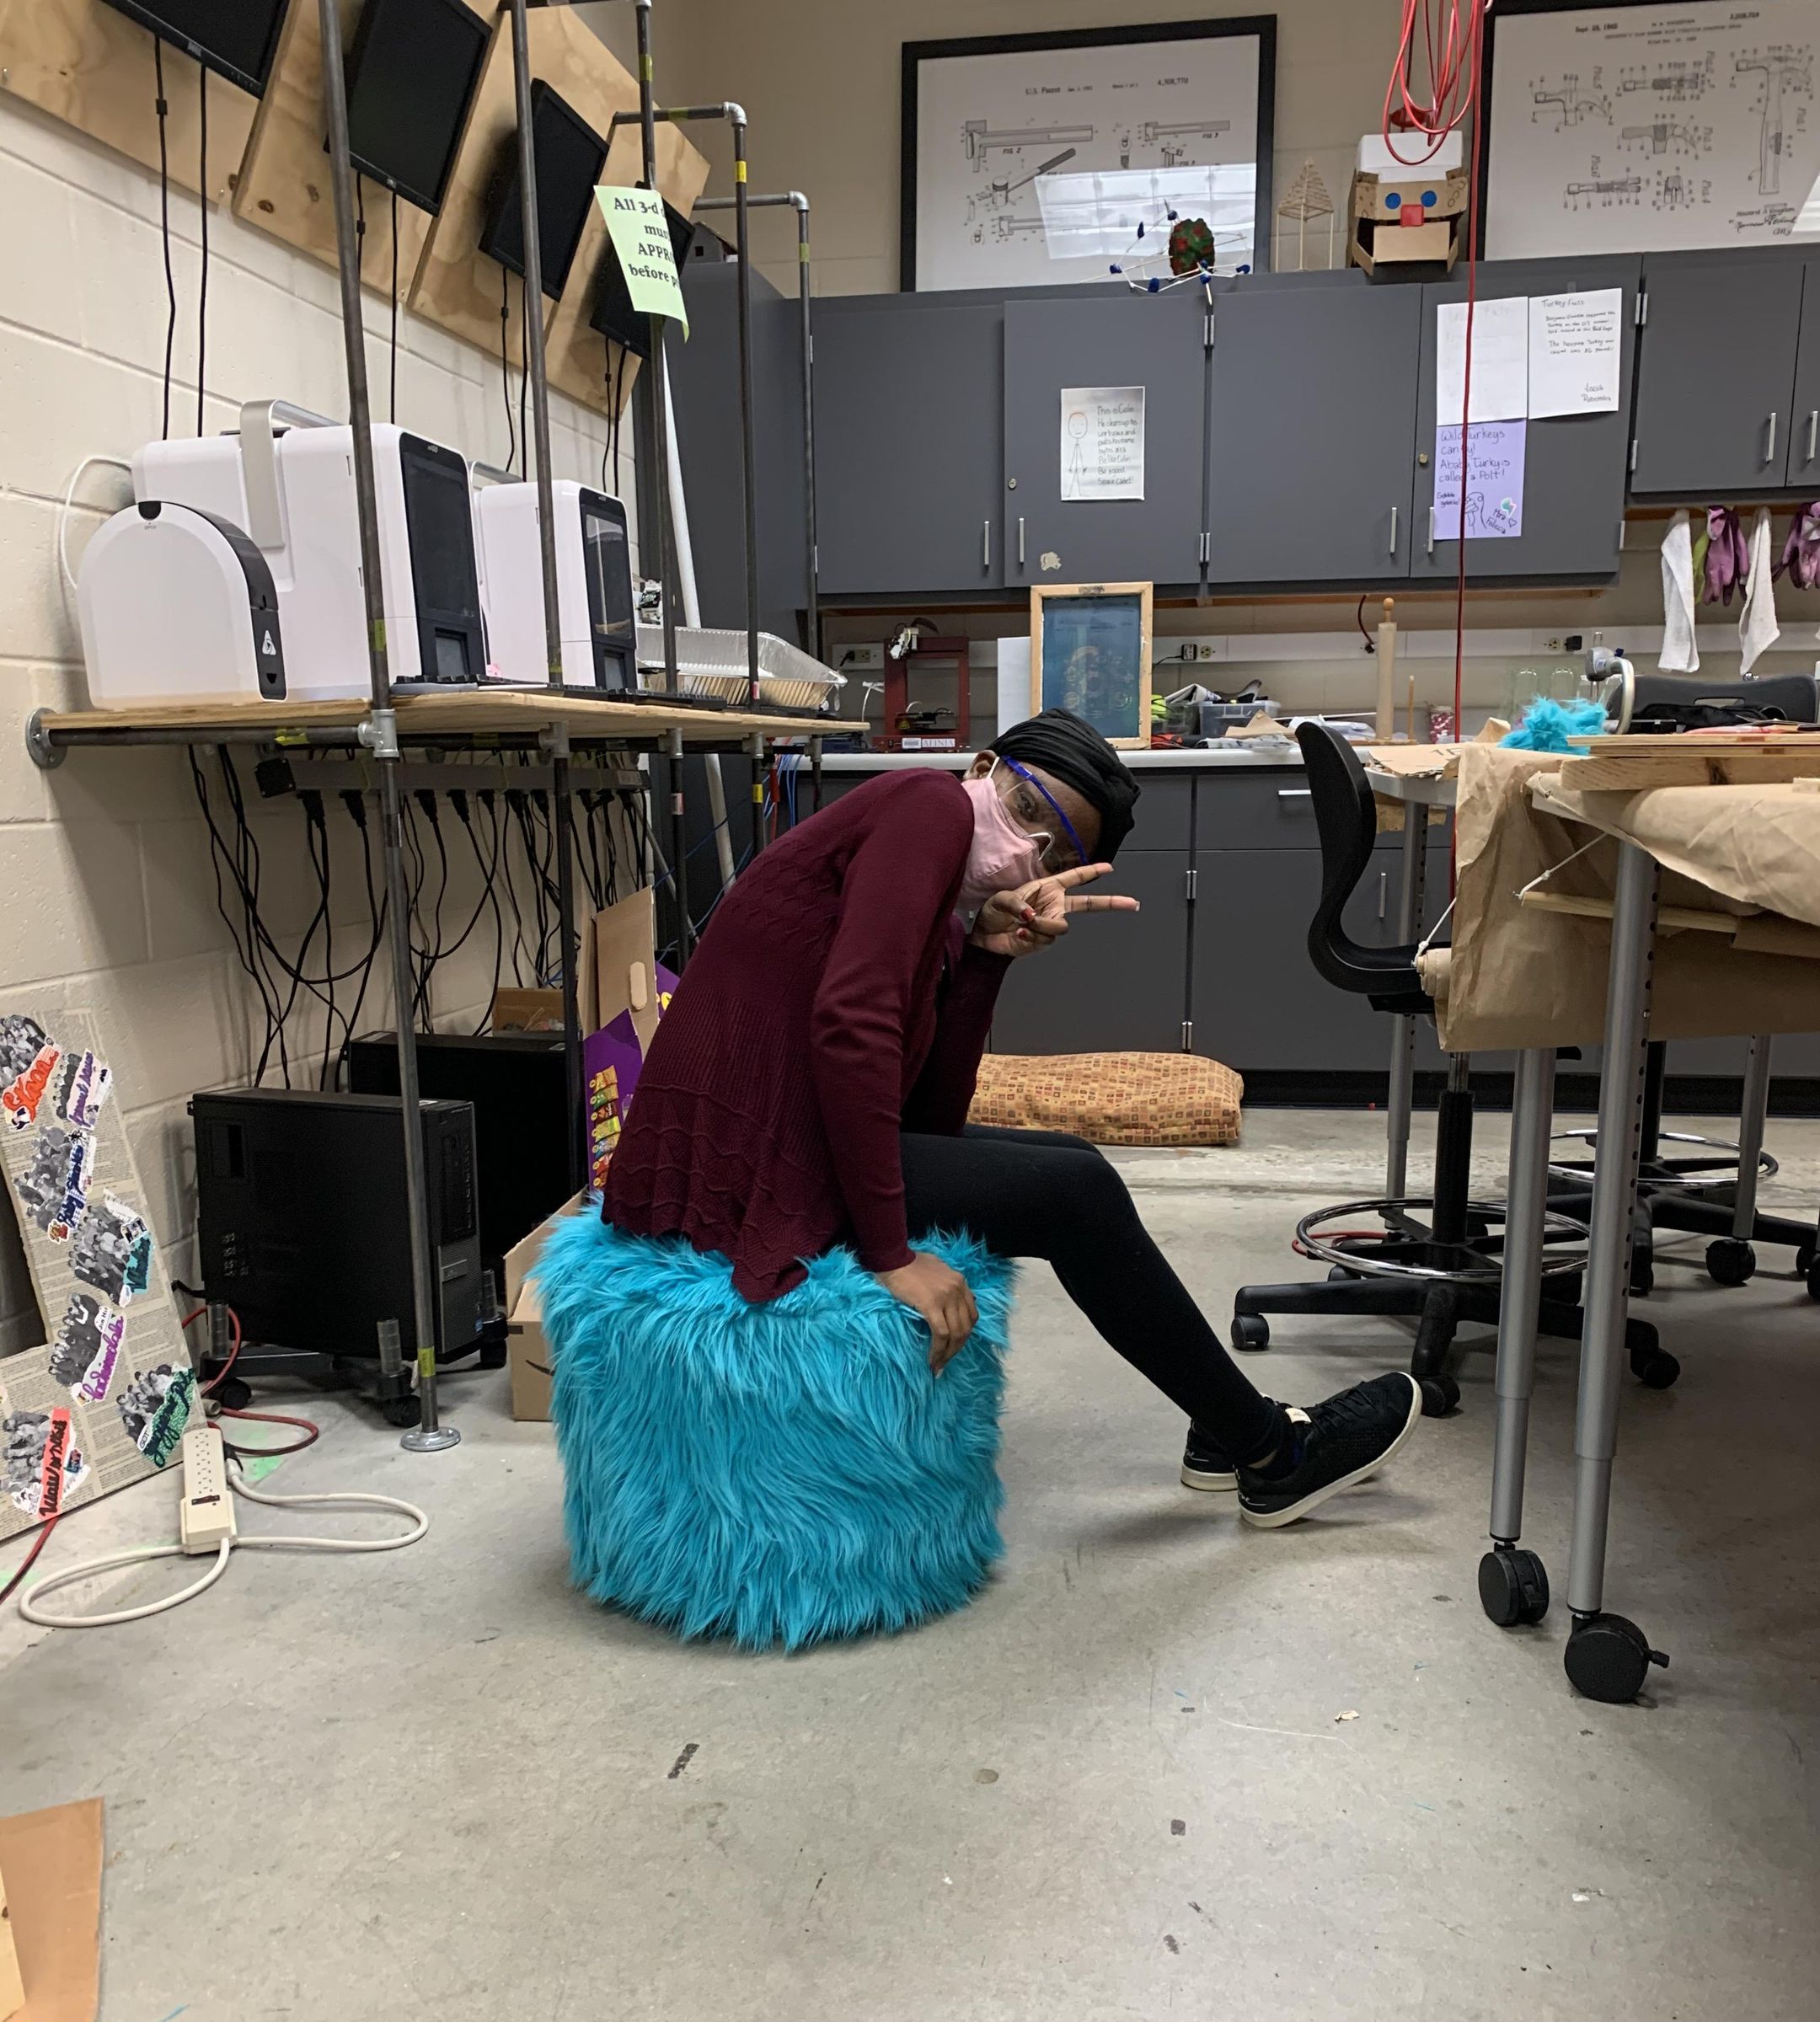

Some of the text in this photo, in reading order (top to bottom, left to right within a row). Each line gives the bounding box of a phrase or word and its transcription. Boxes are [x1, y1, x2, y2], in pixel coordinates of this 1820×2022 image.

[613, 197, 637, 211] All
[638, 201, 660, 216] 3-d
[644, 224, 671, 241] mus
[628, 263, 670, 283] before
[1541, 298, 1566, 308] Turkey
[1467, 426, 1506, 445] Turkeys
[1440, 446, 1460, 455] can
